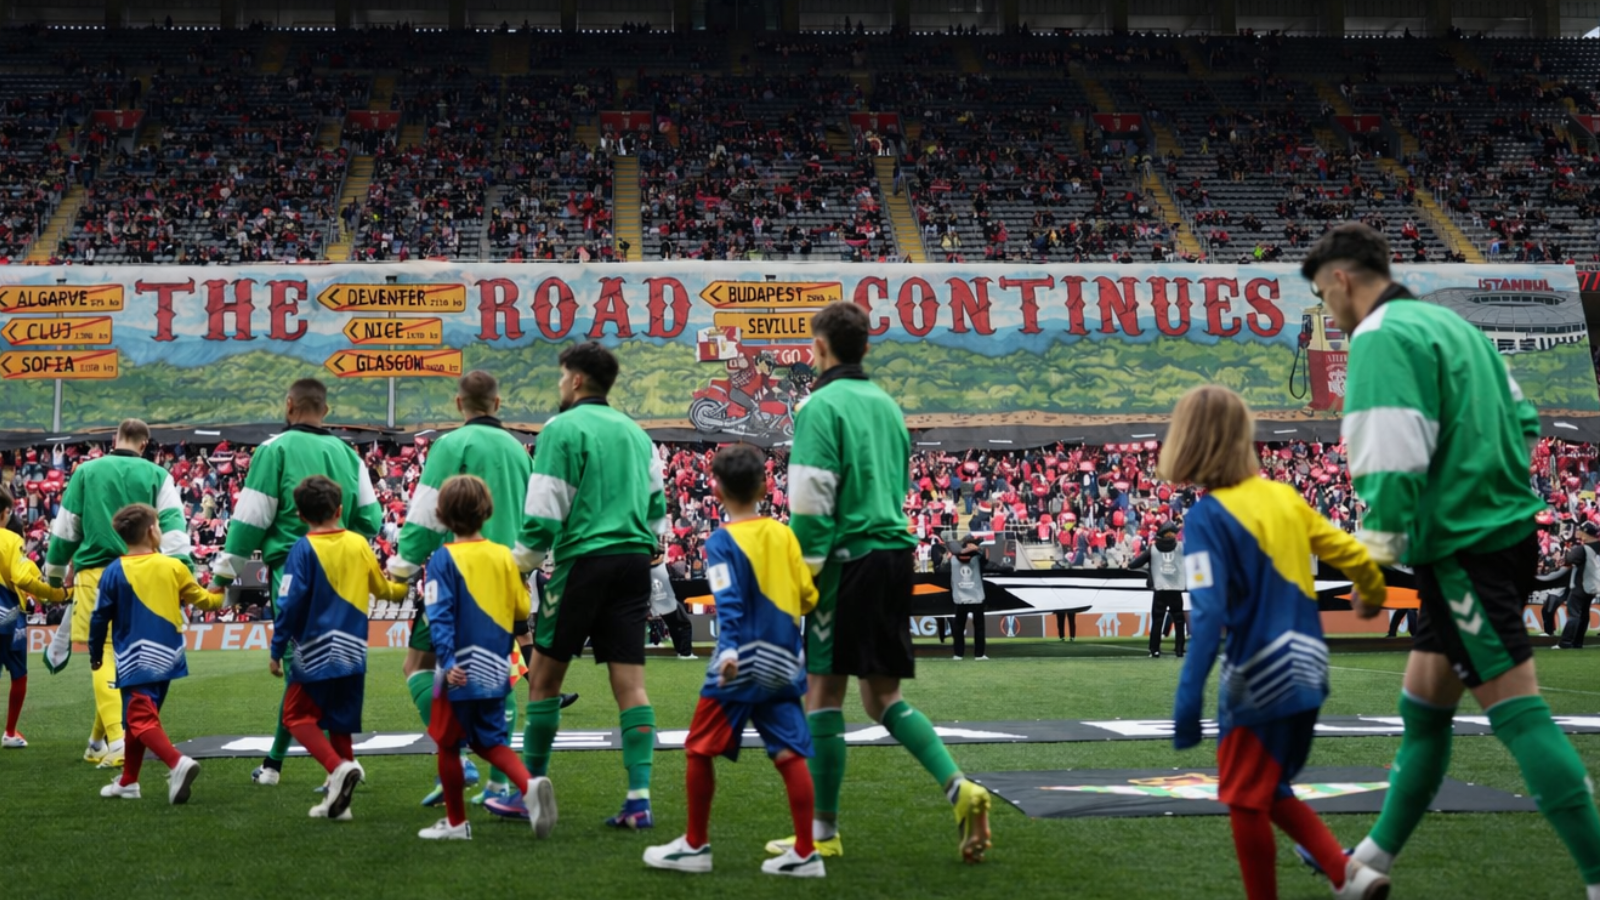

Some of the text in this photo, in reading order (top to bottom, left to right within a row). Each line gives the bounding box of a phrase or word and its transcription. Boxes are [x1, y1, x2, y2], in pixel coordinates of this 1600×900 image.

[1478, 278, 1554, 292] ISTANBUL
[17, 290, 88, 307] ALGARVE
[347, 288, 427, 306] DEVENTER
[728, 286, 803, 303] BUDAPEST
[135, 274, 1285, 342] THE ROAD CONTINUES
[27, 322, 71, 340] CLUJ
[364, 322, 404, 339] NICE
[748, 317, 806, 334] SEVILLE
[21, 356, 74, 373] SOFIA
[356, 354, 424, 372] GLASGOW
